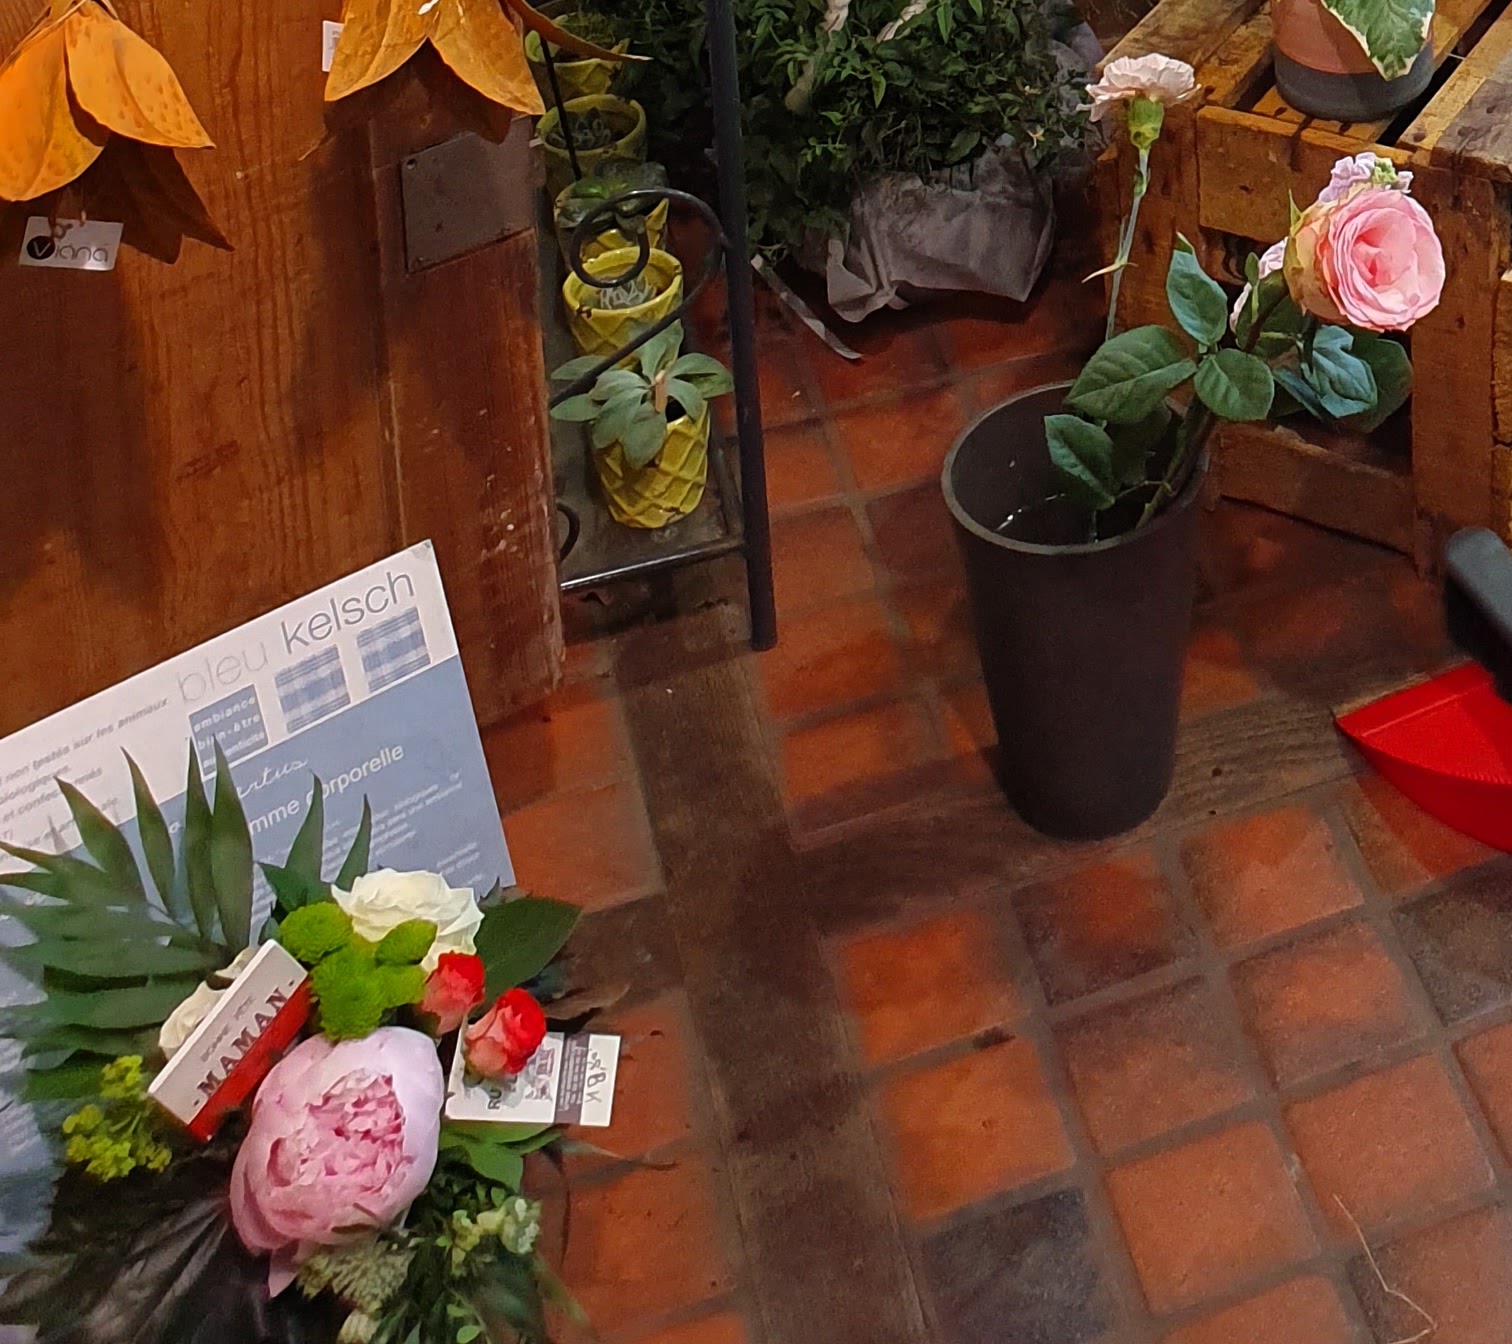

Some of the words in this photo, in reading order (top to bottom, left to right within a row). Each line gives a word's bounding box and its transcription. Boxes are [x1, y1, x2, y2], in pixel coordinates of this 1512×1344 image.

[177, 642, 268, 704] bleu
[281, 572, 414, 655] kelsch
[118, 698, 168, 729] animaux
[197, 987, 287, 1098] MAMAN
